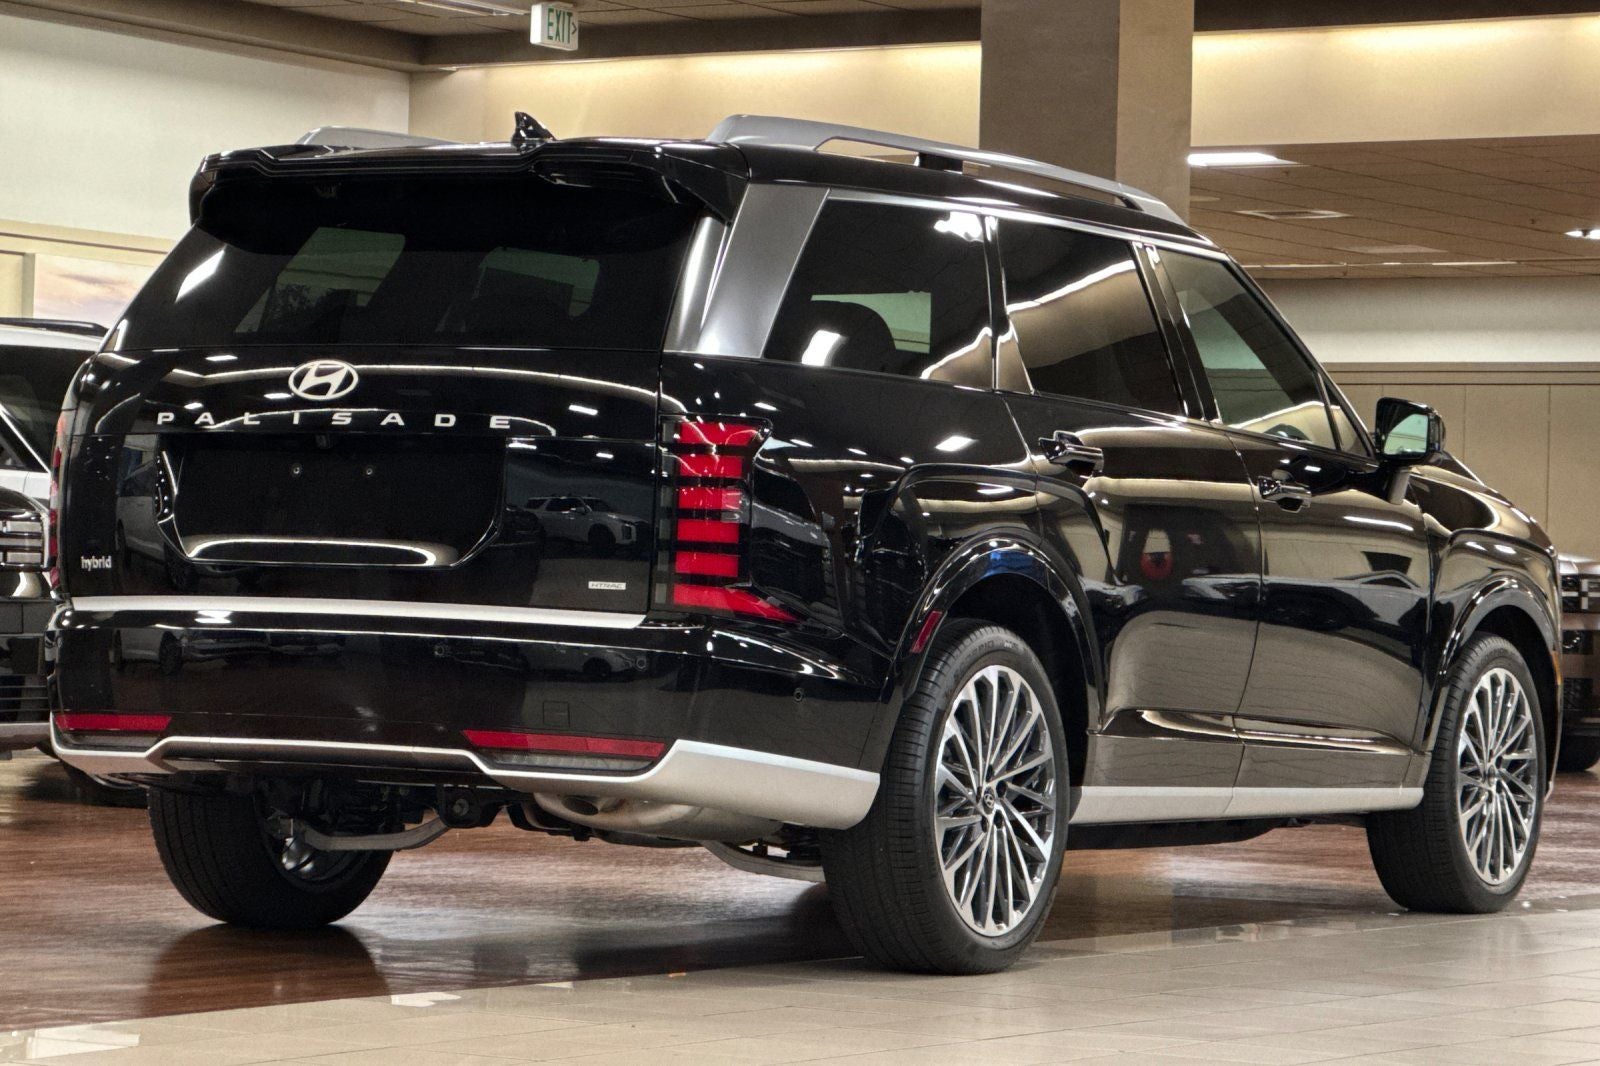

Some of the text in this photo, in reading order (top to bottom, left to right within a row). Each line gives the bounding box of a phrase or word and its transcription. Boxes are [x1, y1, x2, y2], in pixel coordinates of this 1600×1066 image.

[547, 8, 573, 44] EXIT
[156, 411, 512, 429] PALISADE
[81, 555, 112, 571] hybrid
